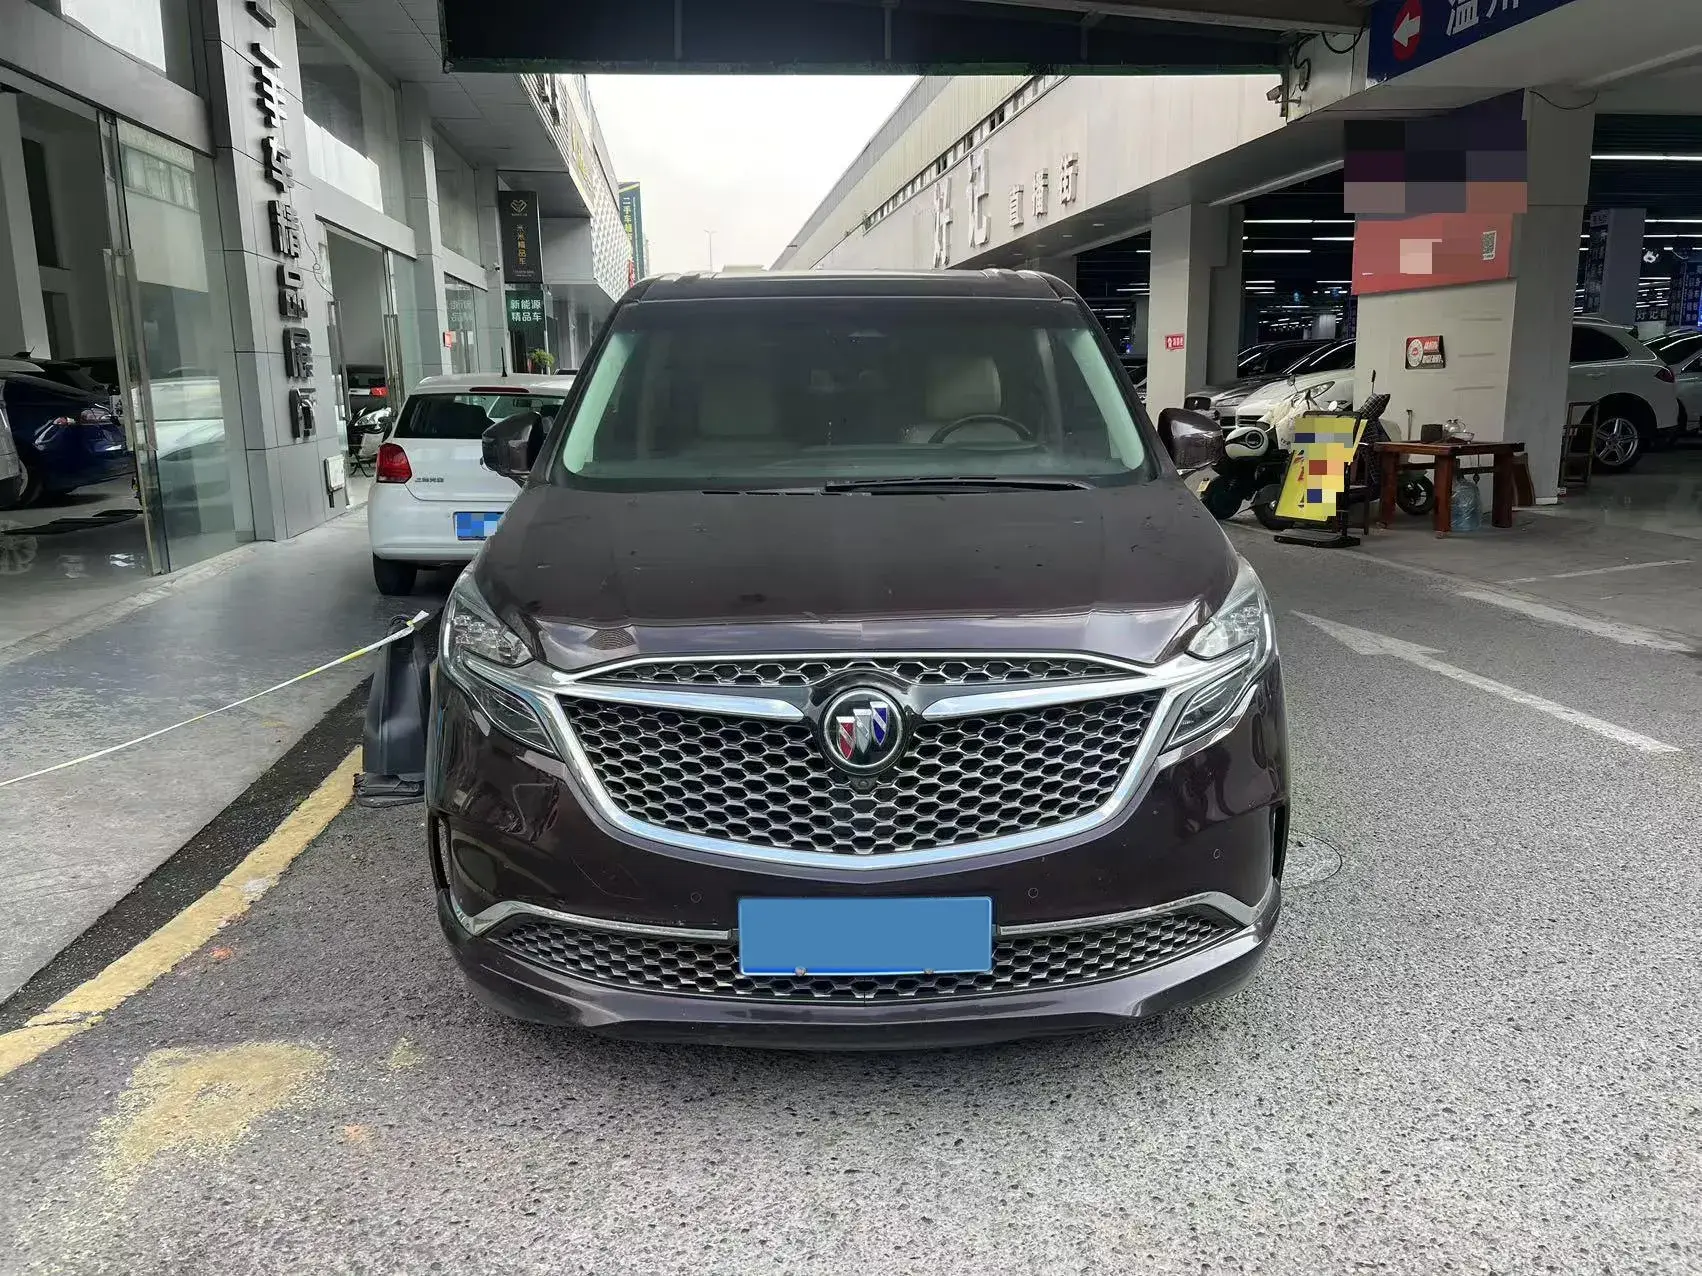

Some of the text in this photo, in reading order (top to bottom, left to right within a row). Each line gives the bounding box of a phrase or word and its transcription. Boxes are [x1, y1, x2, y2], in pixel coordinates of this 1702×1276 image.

[510, 299, 542, 310] 新能源
[511, 312, 543, 322] 精品车
